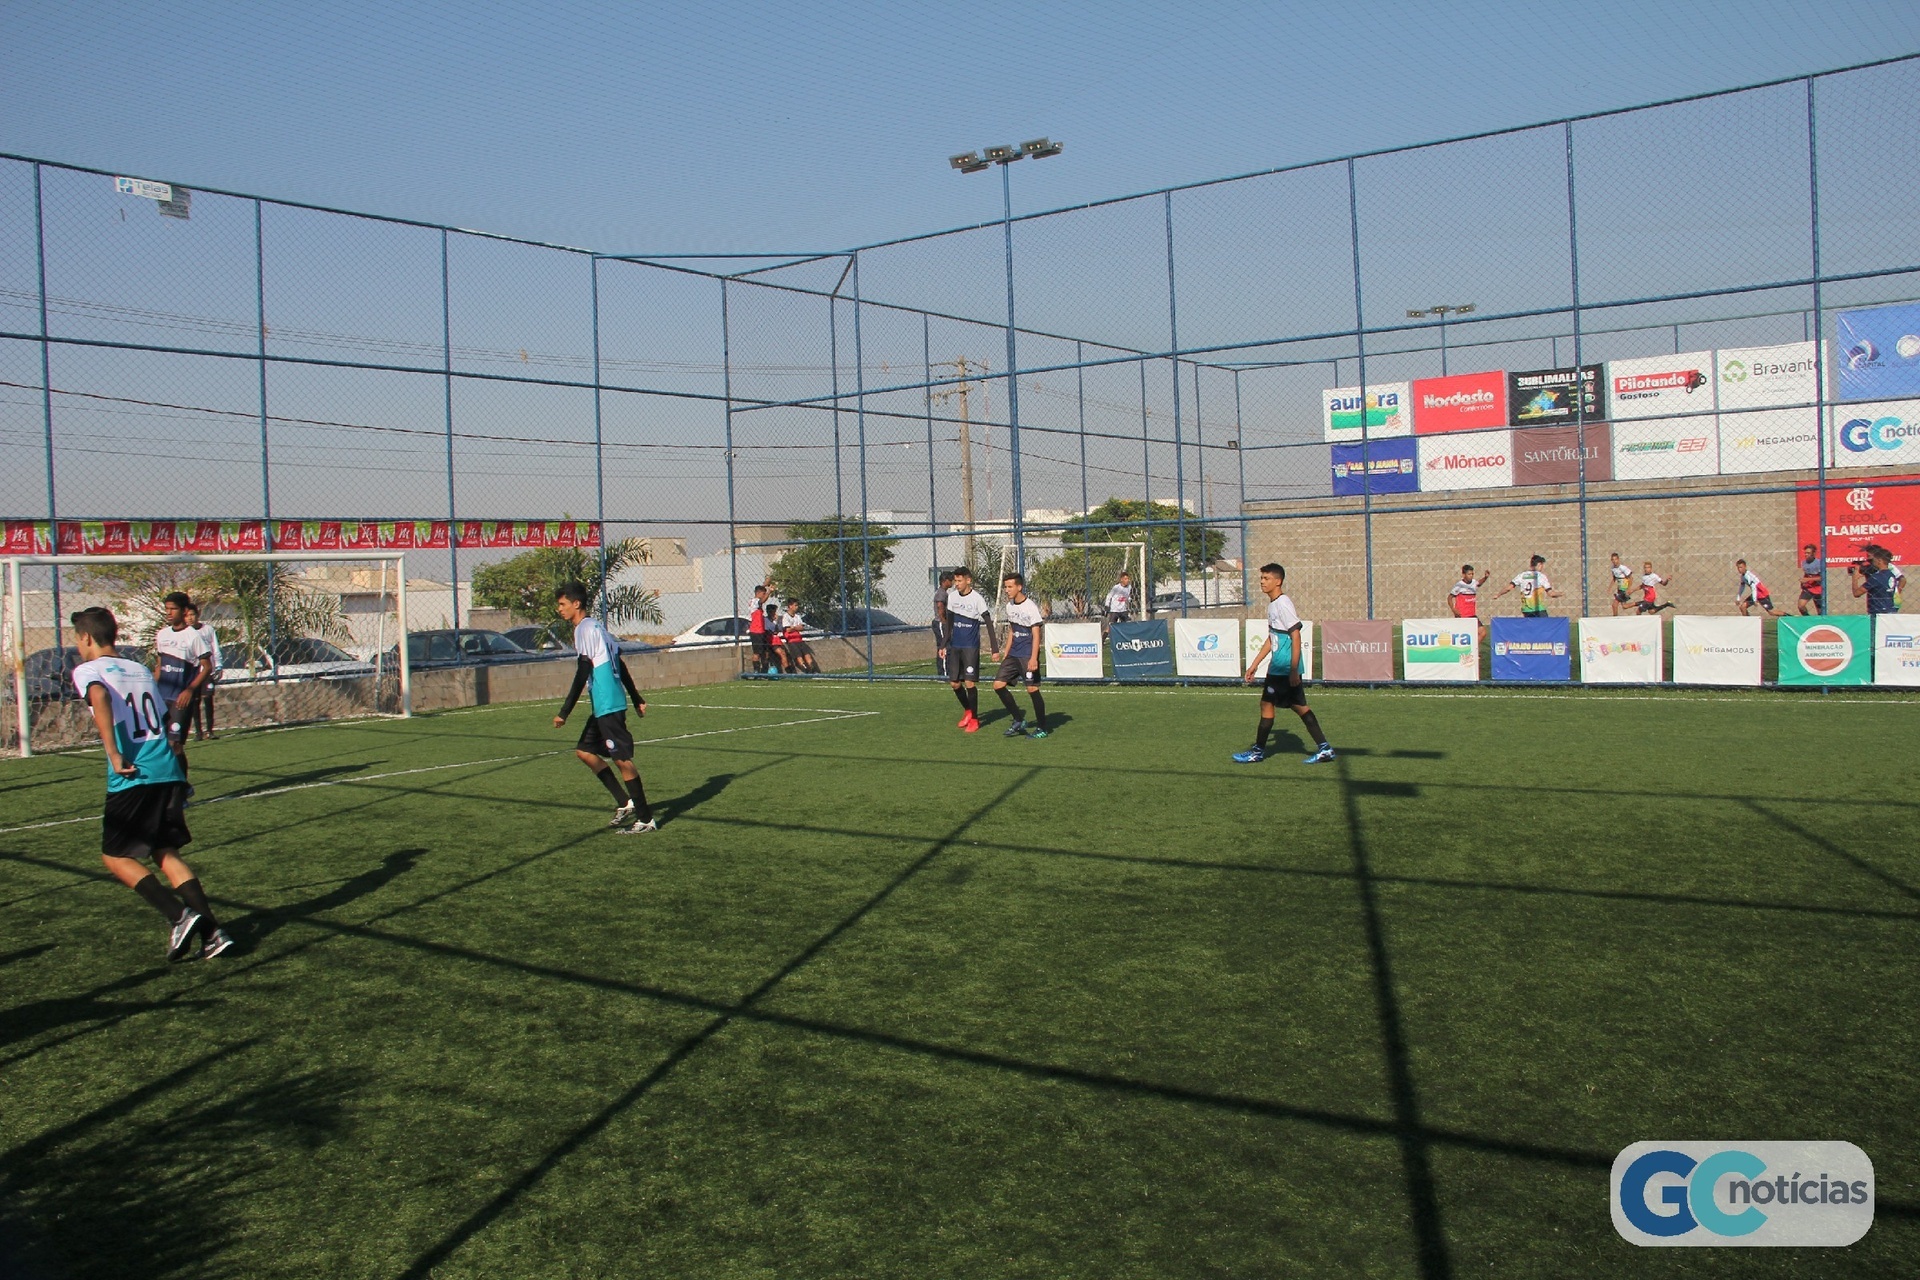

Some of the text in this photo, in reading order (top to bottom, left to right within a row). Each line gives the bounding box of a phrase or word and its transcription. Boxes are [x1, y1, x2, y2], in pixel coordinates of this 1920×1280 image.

[1619, 373, 1686, 390] Pilotando
[1620, 392, 1660, 400] Gostoso
[1757, 434, 1817, 445] MEGAMODA
[1444, 455, 1506, 470] Mônaco
[1839, 514, 1888, 523] ESCOLA
[1825, 524, 1902, 536] FLAMENGO
[1406, 631, 1471, 646] aurora
[1062, 644, 1098, 654] Guarapari
[125, 692, 161, 739] 10
